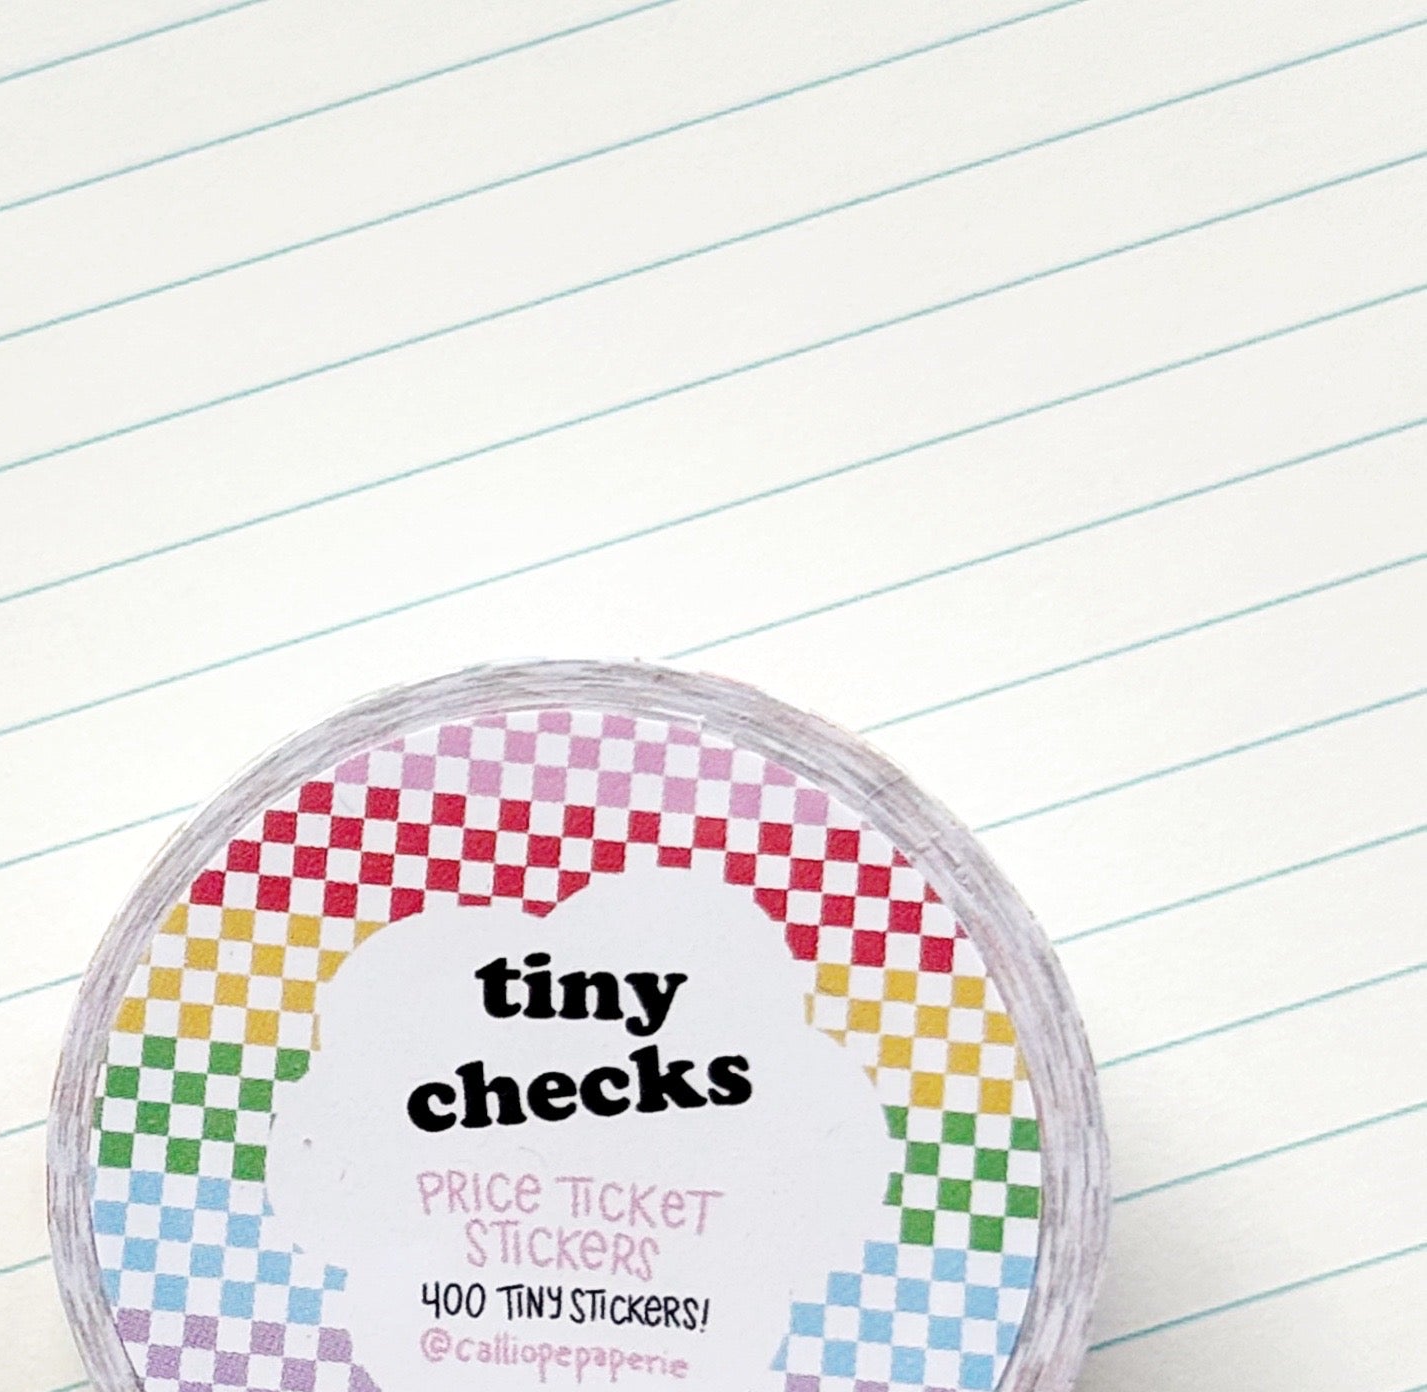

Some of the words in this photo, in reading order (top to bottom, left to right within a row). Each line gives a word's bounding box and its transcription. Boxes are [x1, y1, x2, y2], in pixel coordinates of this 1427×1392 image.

[474, 951, 689, 1037] tiny
[406, 1044, 753, 1133] checks
[421, 1280, 486, 1320] 400
[495, 1283, 563, 1321] TINY
[419, 1326, 690, 1384] @calliopepaperie
